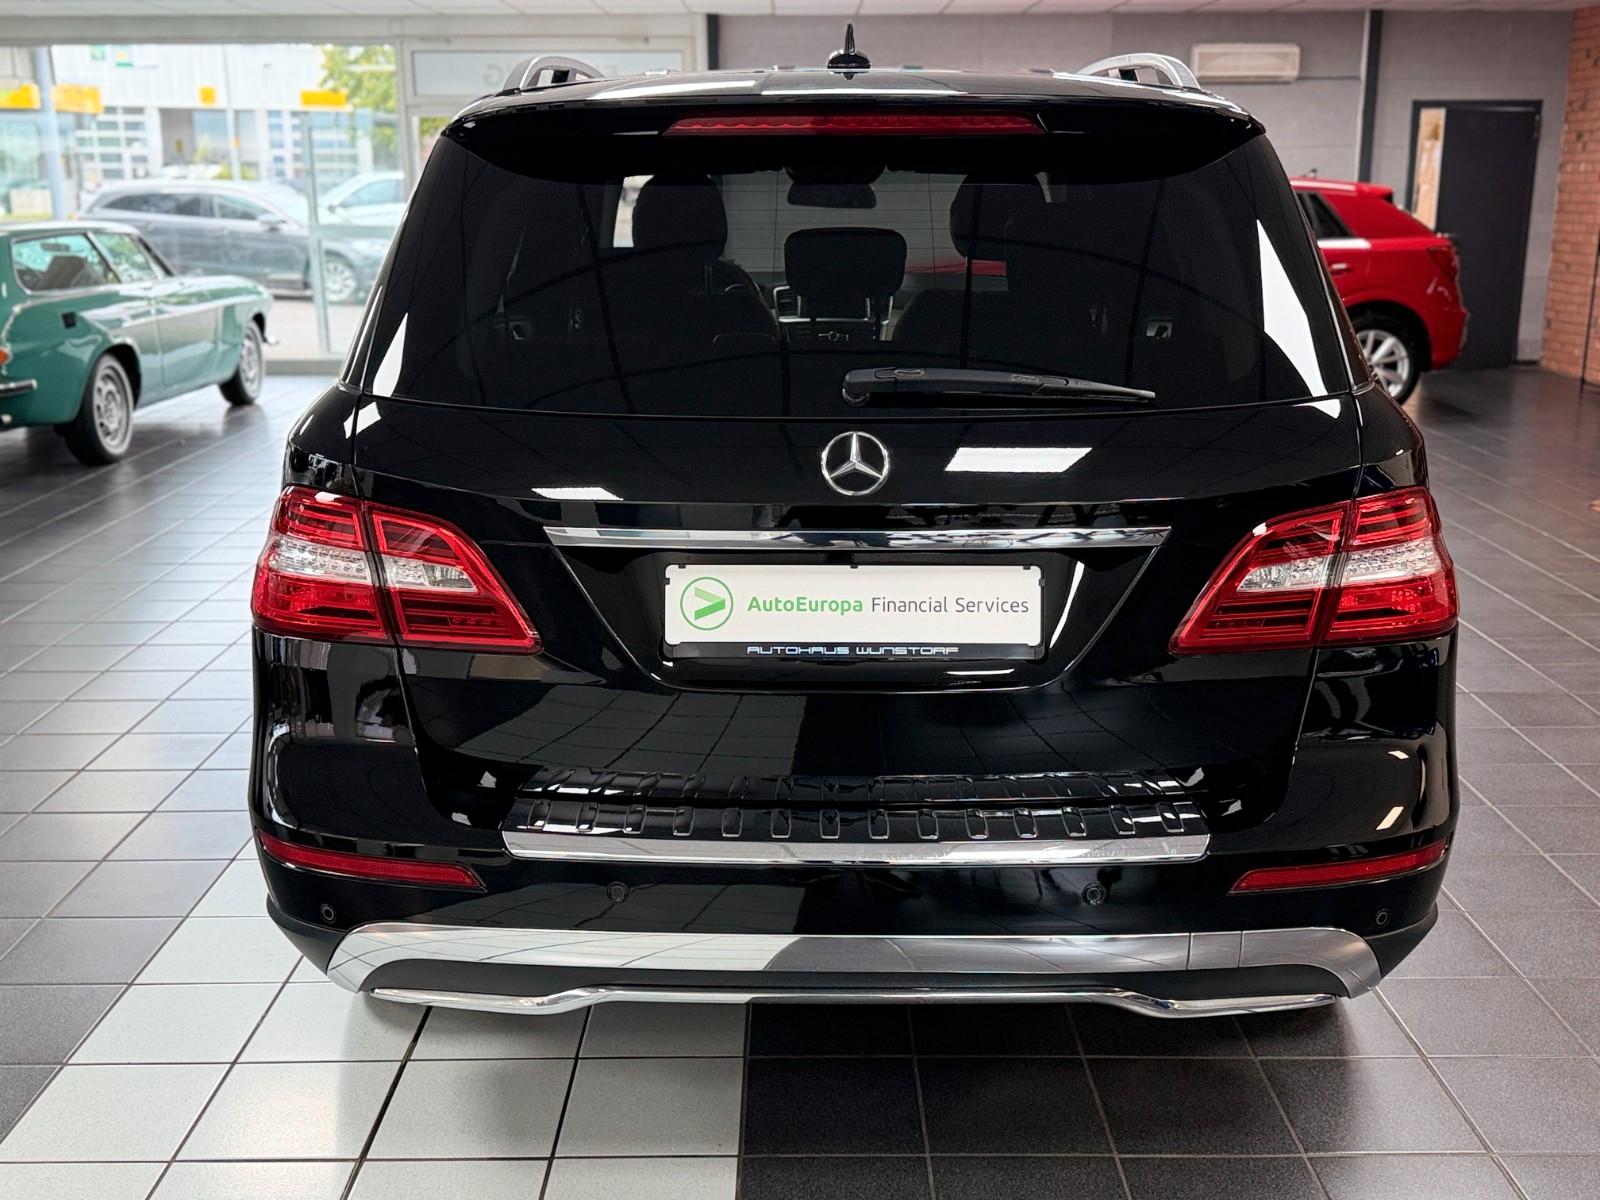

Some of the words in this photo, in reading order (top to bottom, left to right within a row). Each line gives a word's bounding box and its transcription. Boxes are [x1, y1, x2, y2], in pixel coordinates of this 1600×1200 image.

[747, 596, 863, 616] AutoEuropa
[871, 596, 948, 613] Financial
[955, 597, 1029, 613] Services
[746, 646, 850, 655] AUTOHAUS
[856, 646, 959, 655] WUNSTORF
